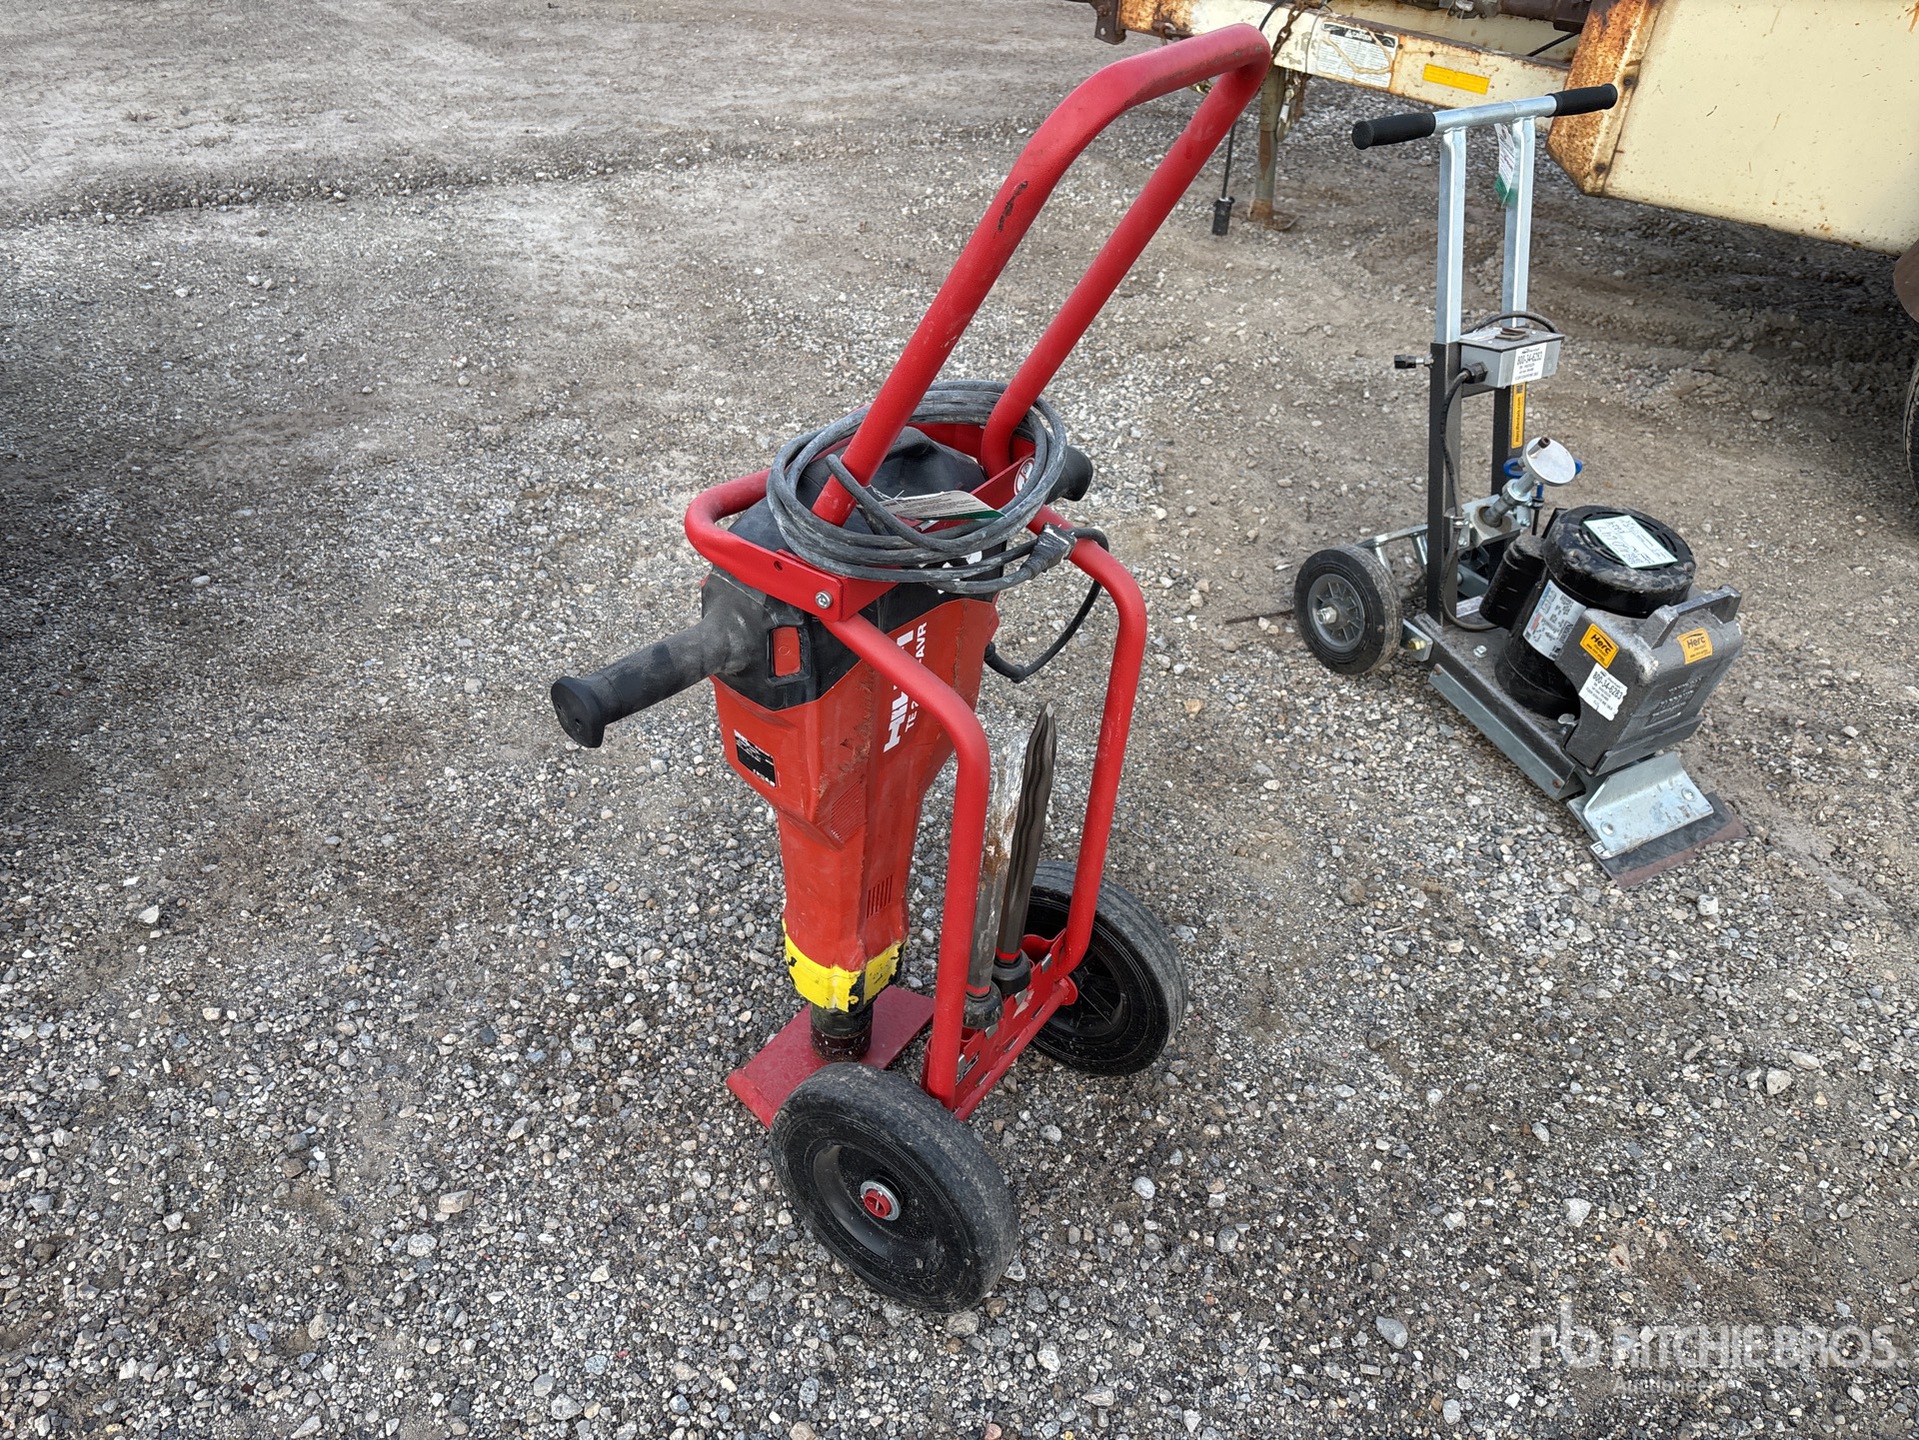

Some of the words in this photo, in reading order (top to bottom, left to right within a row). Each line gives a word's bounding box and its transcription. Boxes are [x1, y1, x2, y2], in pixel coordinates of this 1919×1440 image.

[1590, 633, 1612, 655] Herc
[1686, 635, 1706, 649] Herc
[883, 629, 914, 753] HILI
[1592, 671, 1623, 700] 800-34-6283
[905, 710, 918, 733] TE
